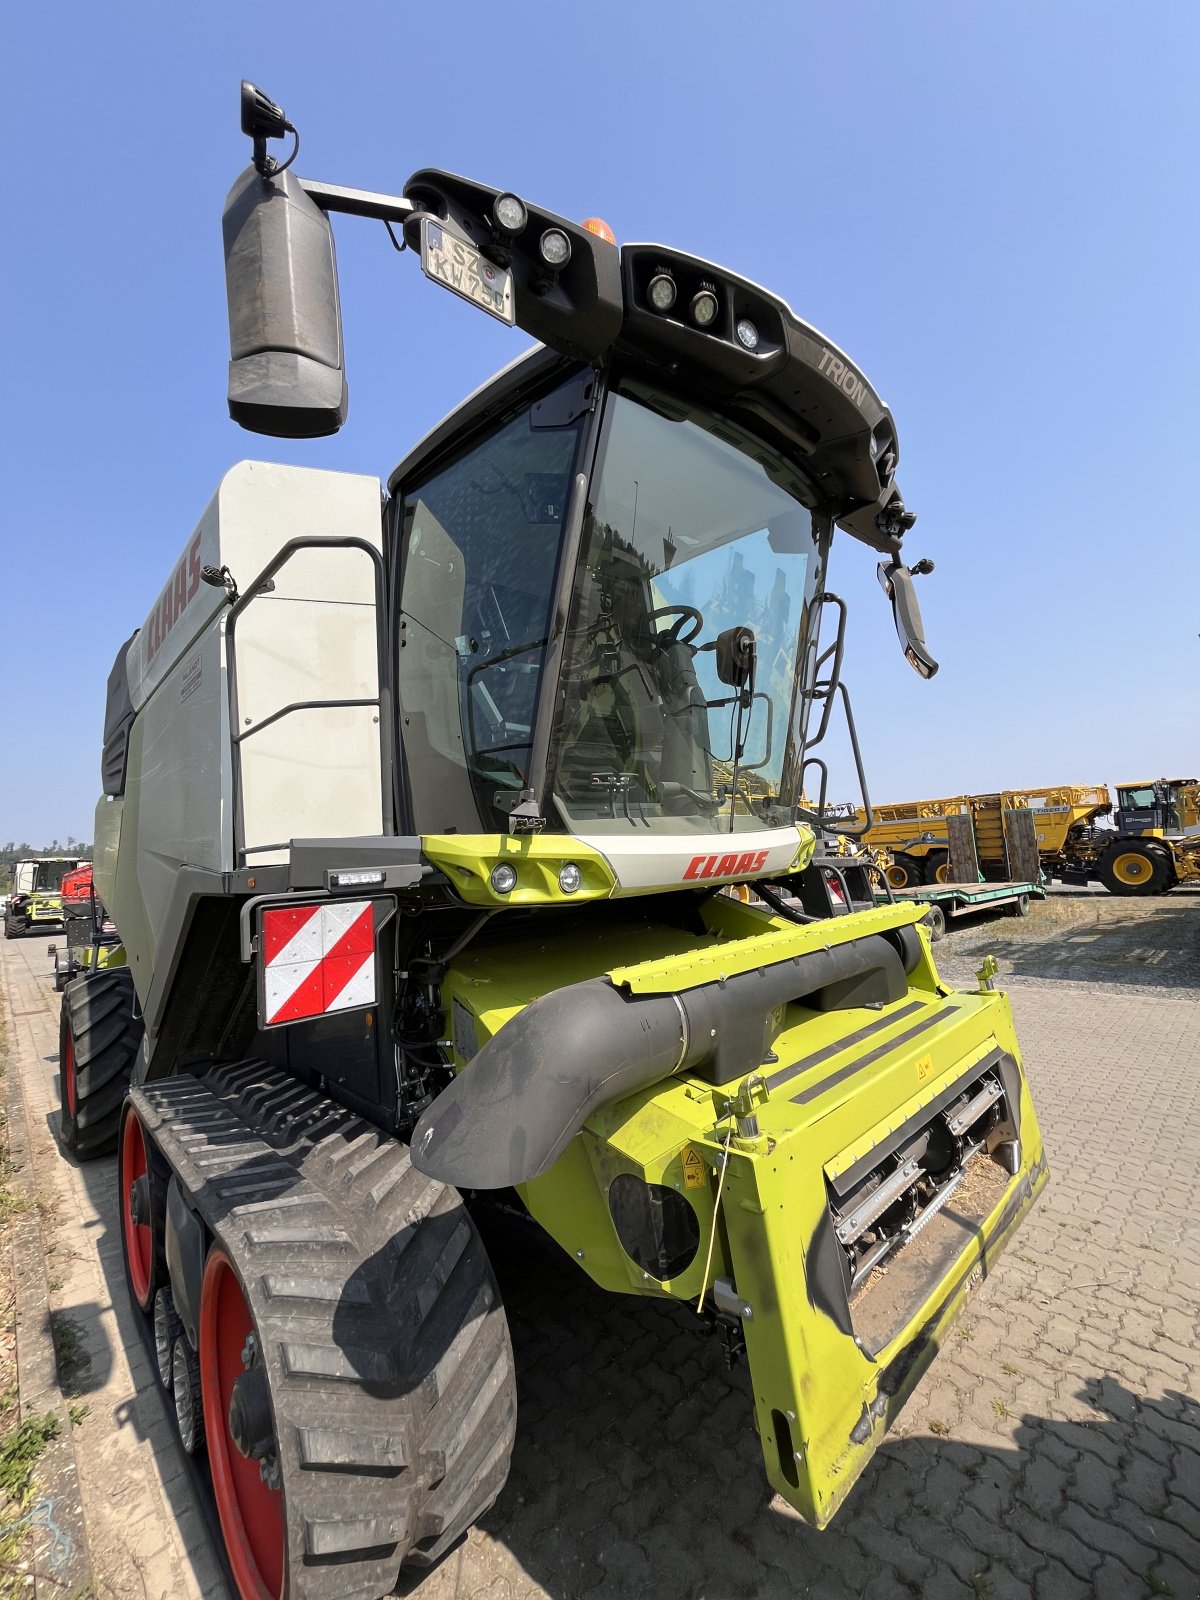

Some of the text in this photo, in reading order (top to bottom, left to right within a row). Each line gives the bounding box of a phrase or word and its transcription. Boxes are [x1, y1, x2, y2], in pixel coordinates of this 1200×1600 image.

[454, 242, 479, 277] SZ
[818, 347, 868, 407] TRION
[147, 531, 202, 664] CLAAS
[682, 850, 770, 880] CLAAS
